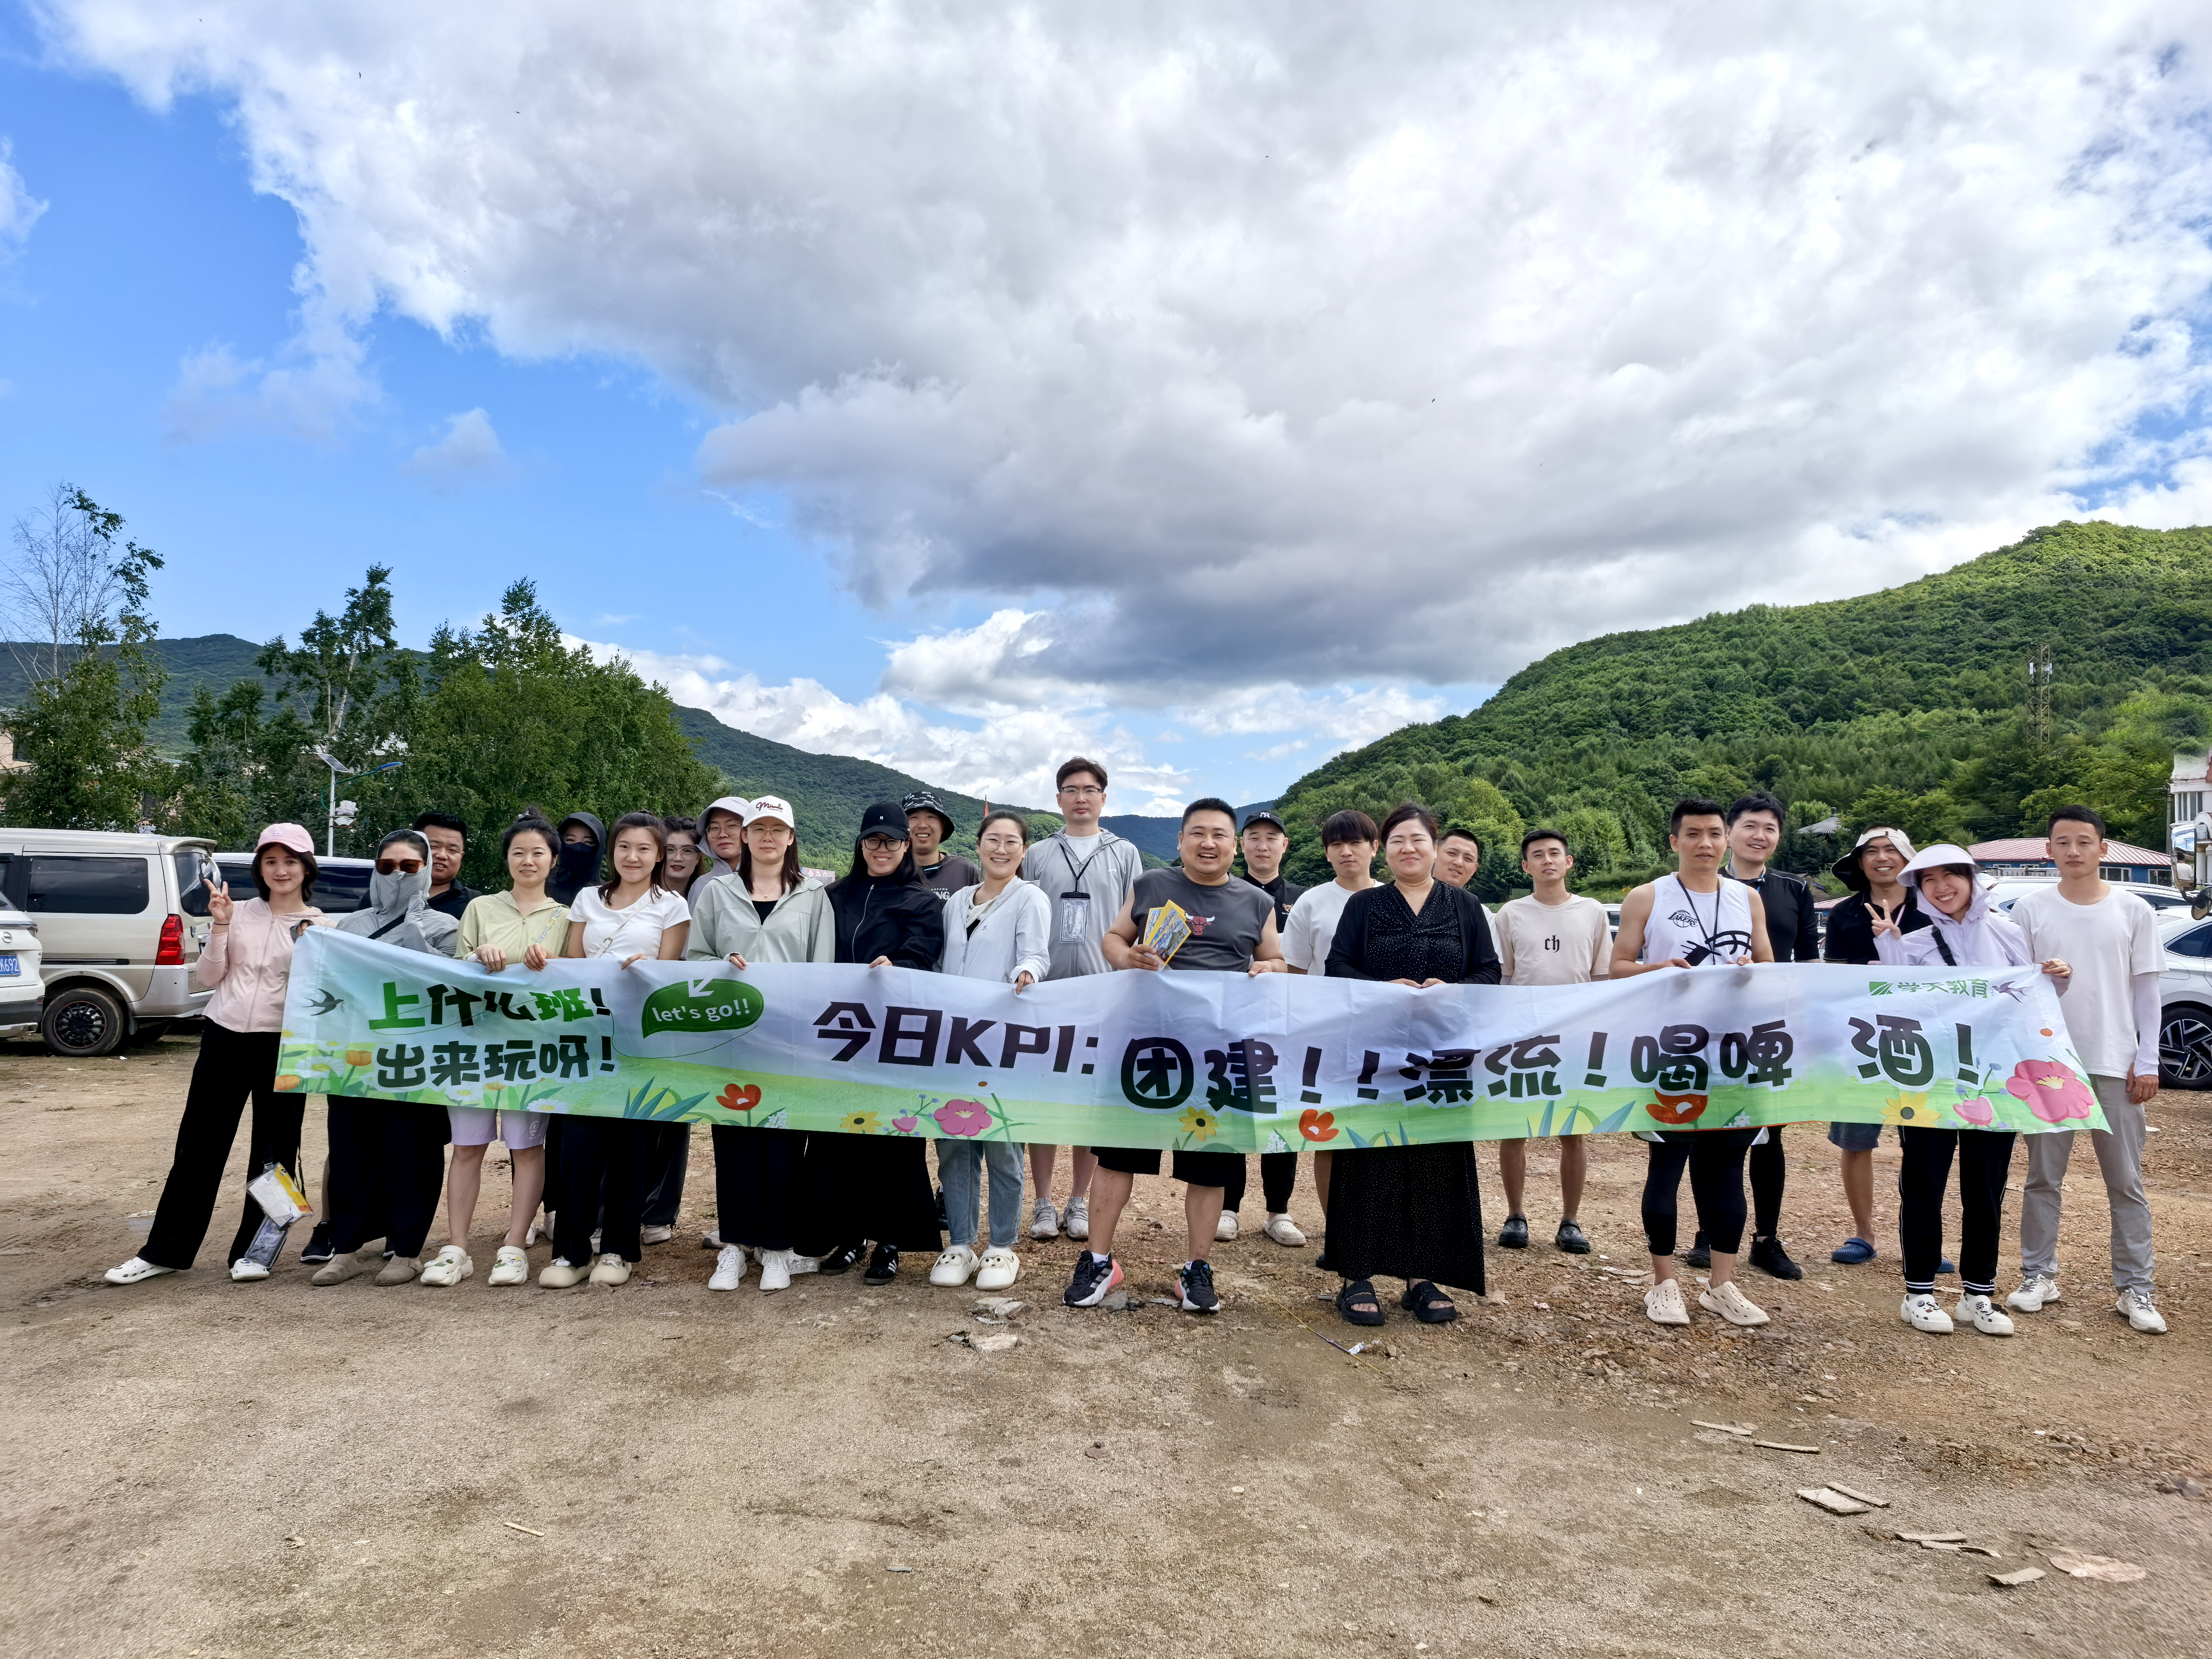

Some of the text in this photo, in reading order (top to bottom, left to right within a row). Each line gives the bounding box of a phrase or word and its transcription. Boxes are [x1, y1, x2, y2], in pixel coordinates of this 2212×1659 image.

[1668, 912, 1698, 927] LAKERS
[0, 958, 19, 972] K692
[652, 998, 750, 1023] let's go!!
[376, 1035, 615, 1088] 出来玩呀!
